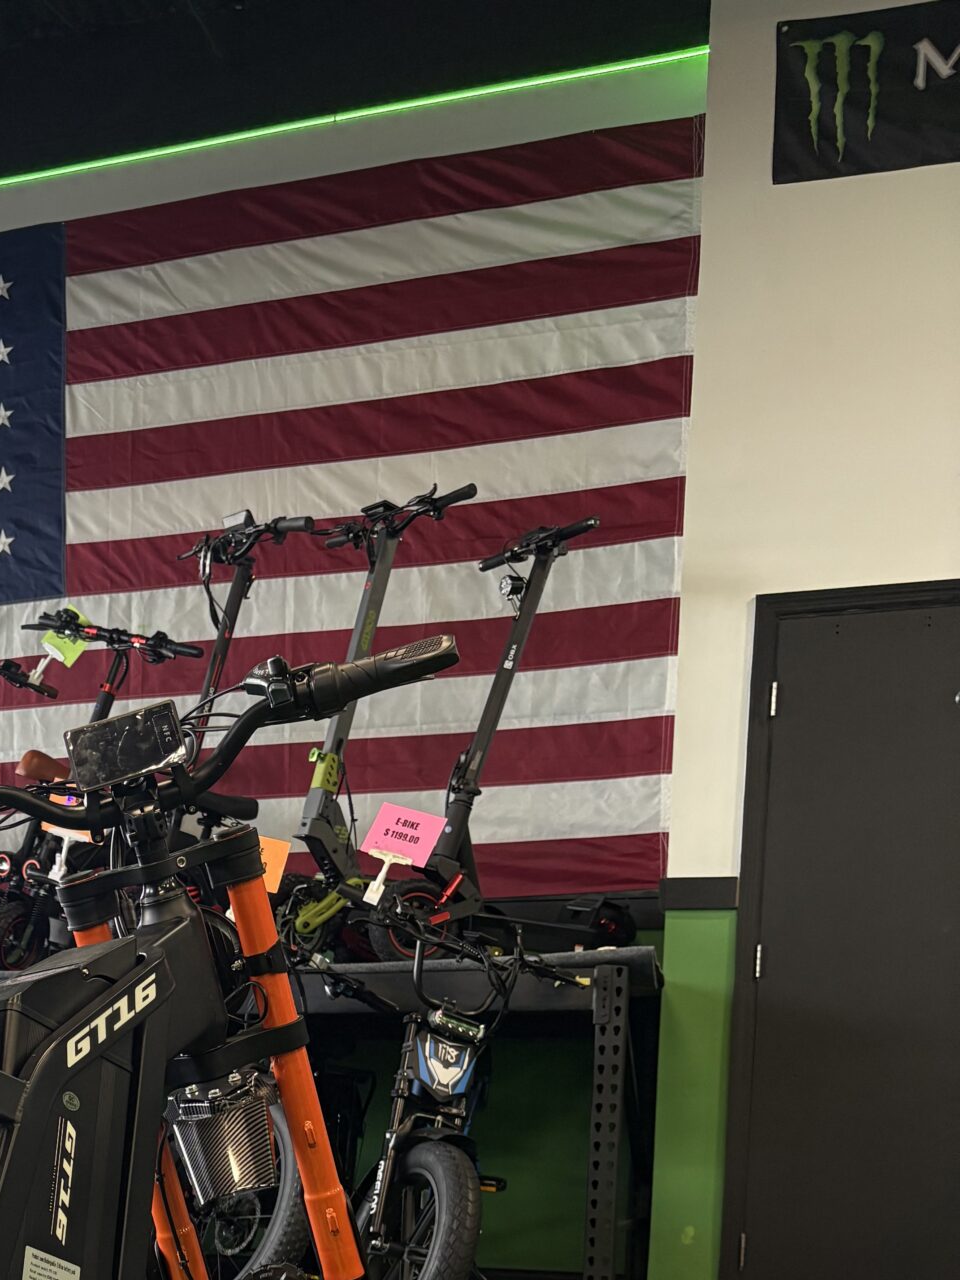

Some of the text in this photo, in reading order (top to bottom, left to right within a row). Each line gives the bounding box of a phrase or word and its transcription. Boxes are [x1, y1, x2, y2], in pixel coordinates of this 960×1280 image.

[161, 724, 173, 743] NFC
[395, 817, 421, 831] E-BIKE
[390, 830, 420, 845] 1199.00
[66, 972, 157, 1068] GT16
[55, 1120, 77, 1247] GT16
